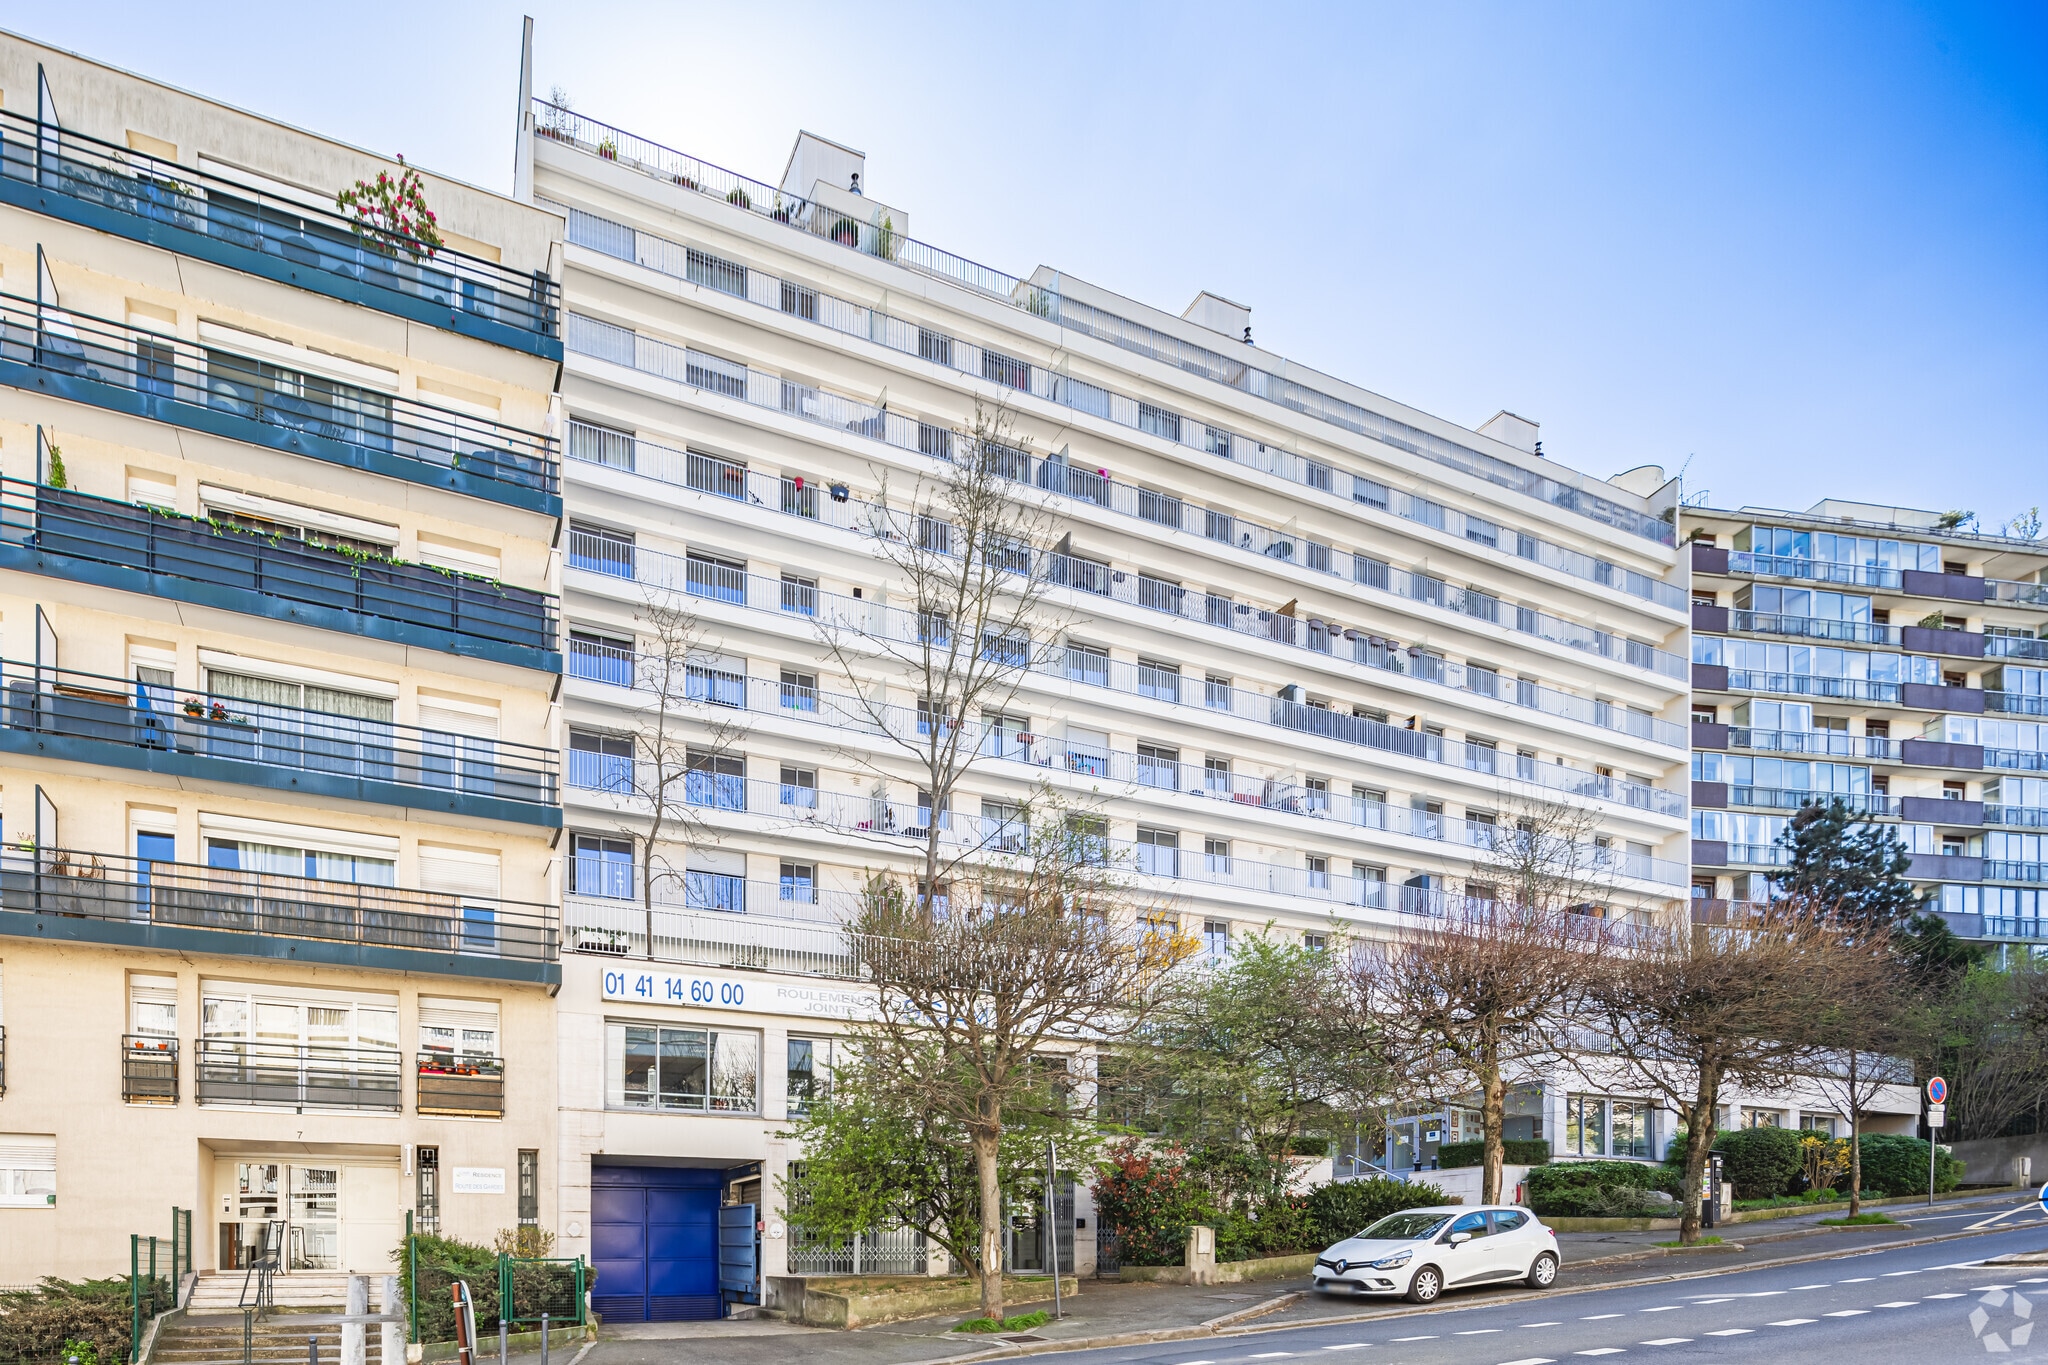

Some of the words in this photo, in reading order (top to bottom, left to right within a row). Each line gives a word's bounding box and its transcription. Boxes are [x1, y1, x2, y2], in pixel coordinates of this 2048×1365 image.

[605, 972, 625, 995] 01
[635, 975, 653, 998] 41
[664, 977, 684, 1000] 14
[691, 980, 714, 1003] 60
[721, 983, 744, 1006] 00
[777, 988, 881, 1005] ROULEMENT
[804, 1002, 858, 1015] JOINTS
[296, 1130, 303, 1140] 7
